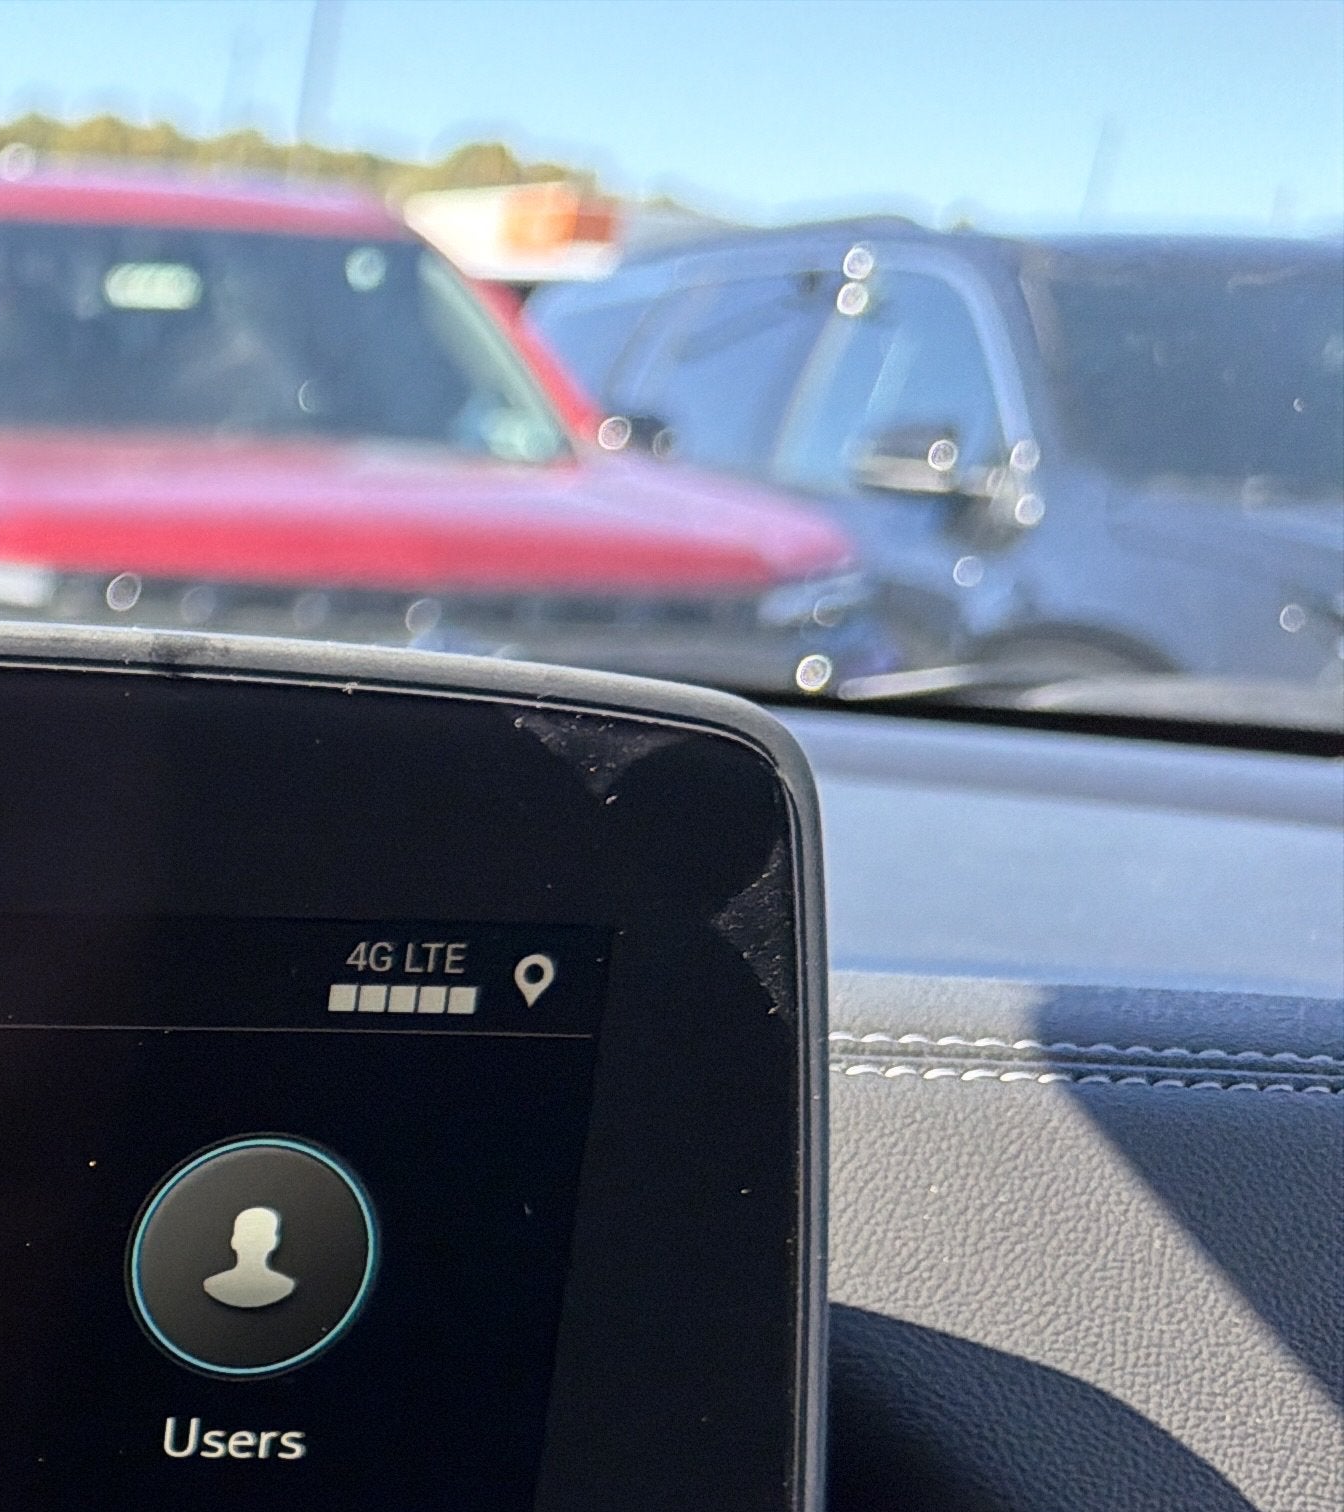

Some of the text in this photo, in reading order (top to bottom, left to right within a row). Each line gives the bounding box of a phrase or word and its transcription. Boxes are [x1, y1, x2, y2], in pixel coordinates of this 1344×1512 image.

[345, 941, 468, 974] 4G LTE
[163, 1417, 307, 1461] Users
